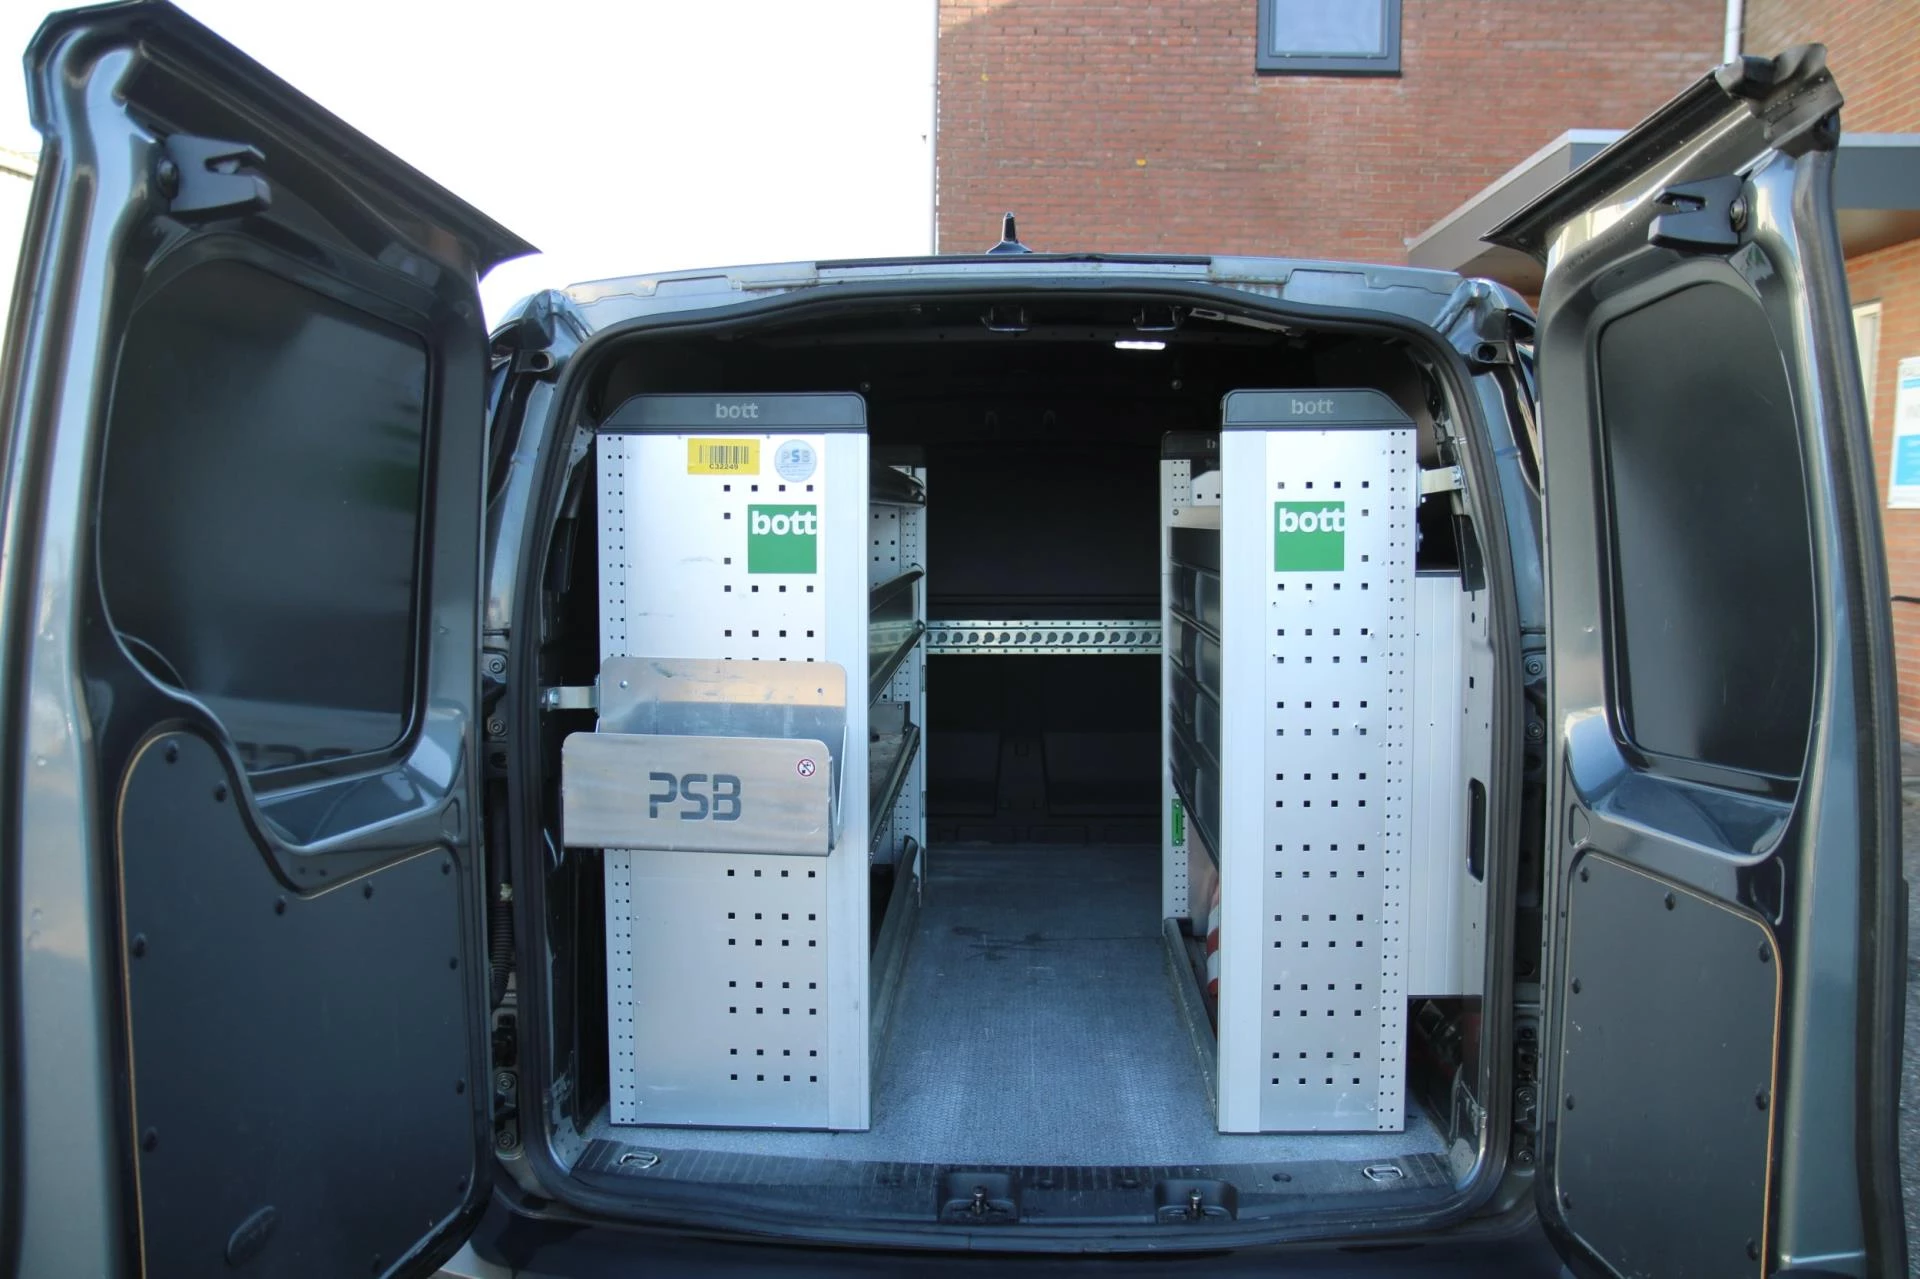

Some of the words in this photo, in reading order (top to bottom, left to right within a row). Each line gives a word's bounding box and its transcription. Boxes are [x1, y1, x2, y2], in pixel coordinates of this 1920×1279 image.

[715, 402, 759, 418] bott
[1291, 400, 1334, 415] bott
[781, 448, 811, 463] PSB
[752, 510, 817, 535] bott
[1279, 508, 1345, 533] bott
[649, 772, 742, 821] PSB
